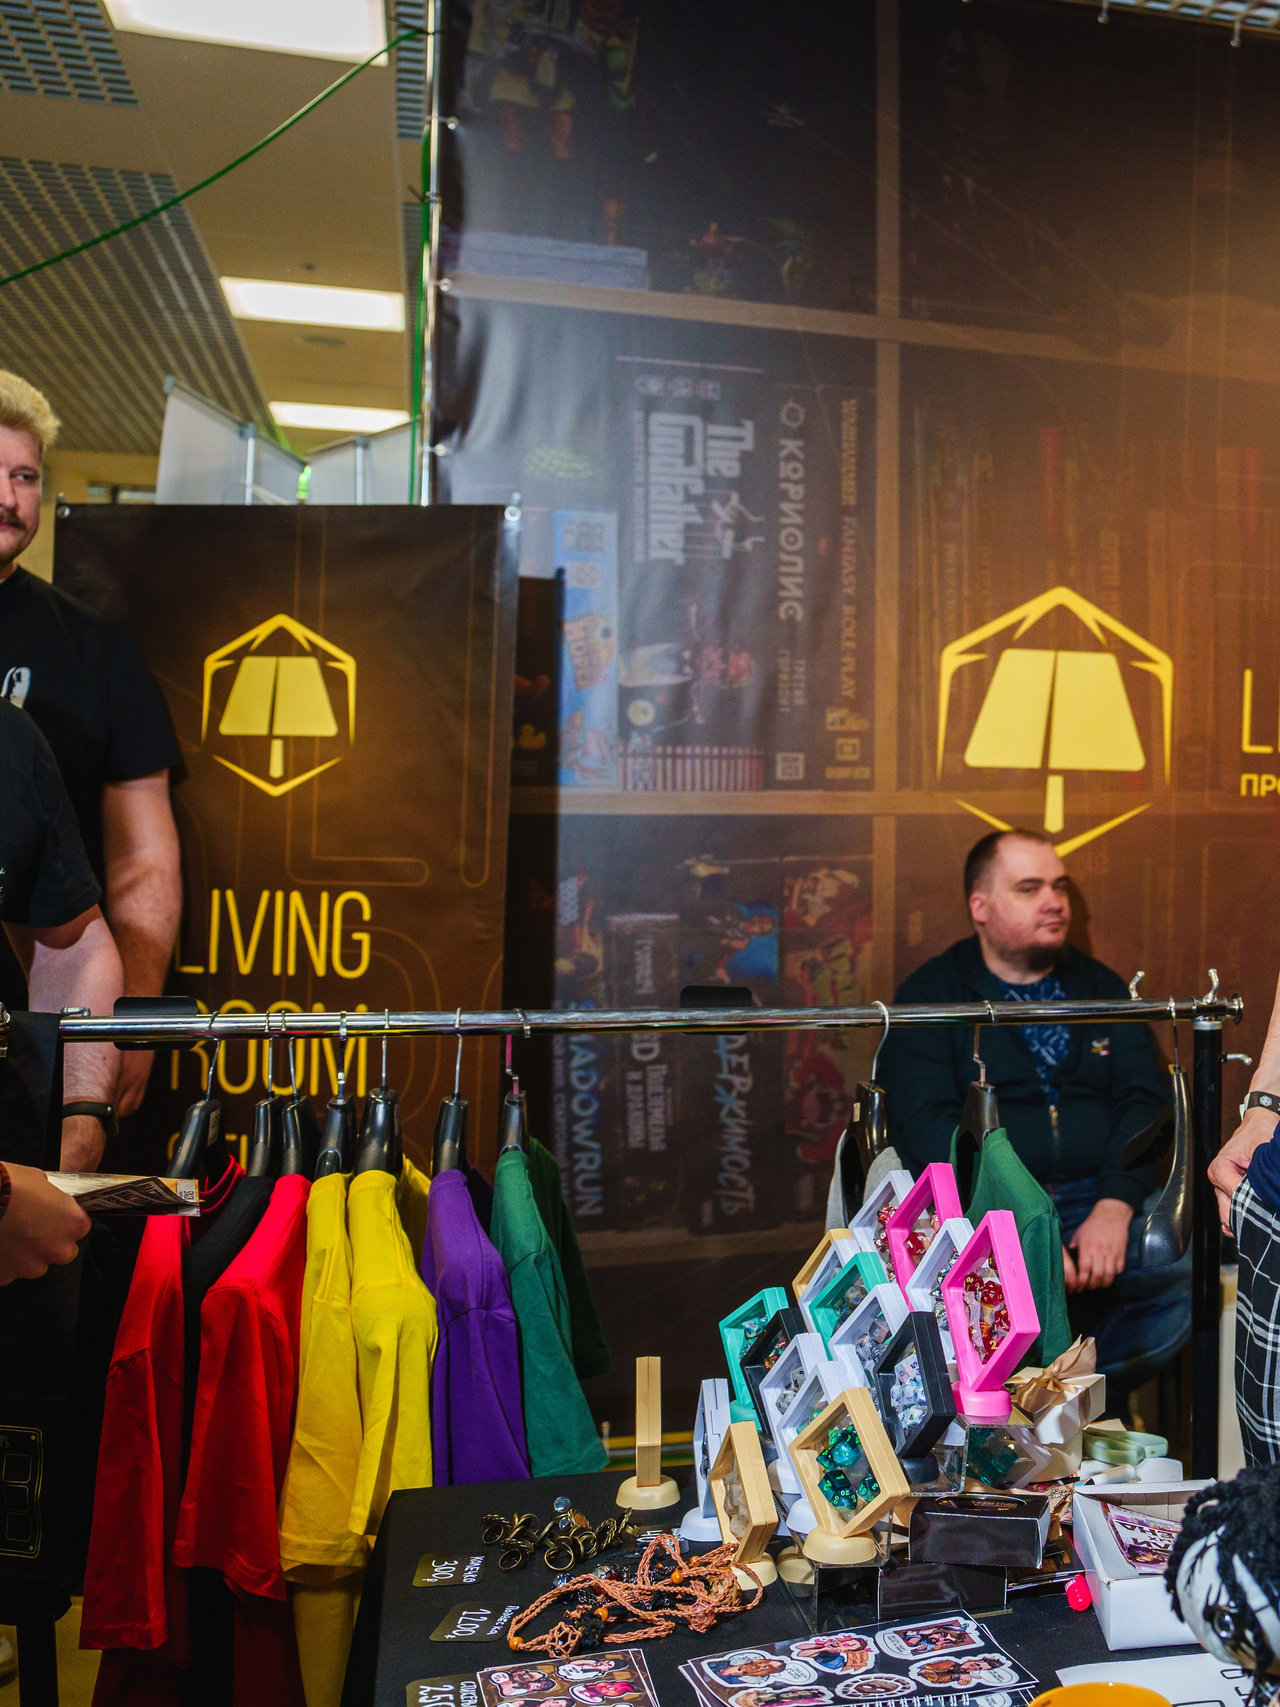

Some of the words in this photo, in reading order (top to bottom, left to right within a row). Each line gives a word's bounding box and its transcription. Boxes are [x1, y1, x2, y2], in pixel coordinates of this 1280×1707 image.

[648, 413, 704, 566] Godfather
[706, 419, 755, 479] The
[839, 516, 858, 597] FANTASY
[174, 888, 373, 978] LIVING
[170, 1000, 370, 1097] ROOM
[713, 1034, 757, 1216] ДЕРЖИМОСТЬ
